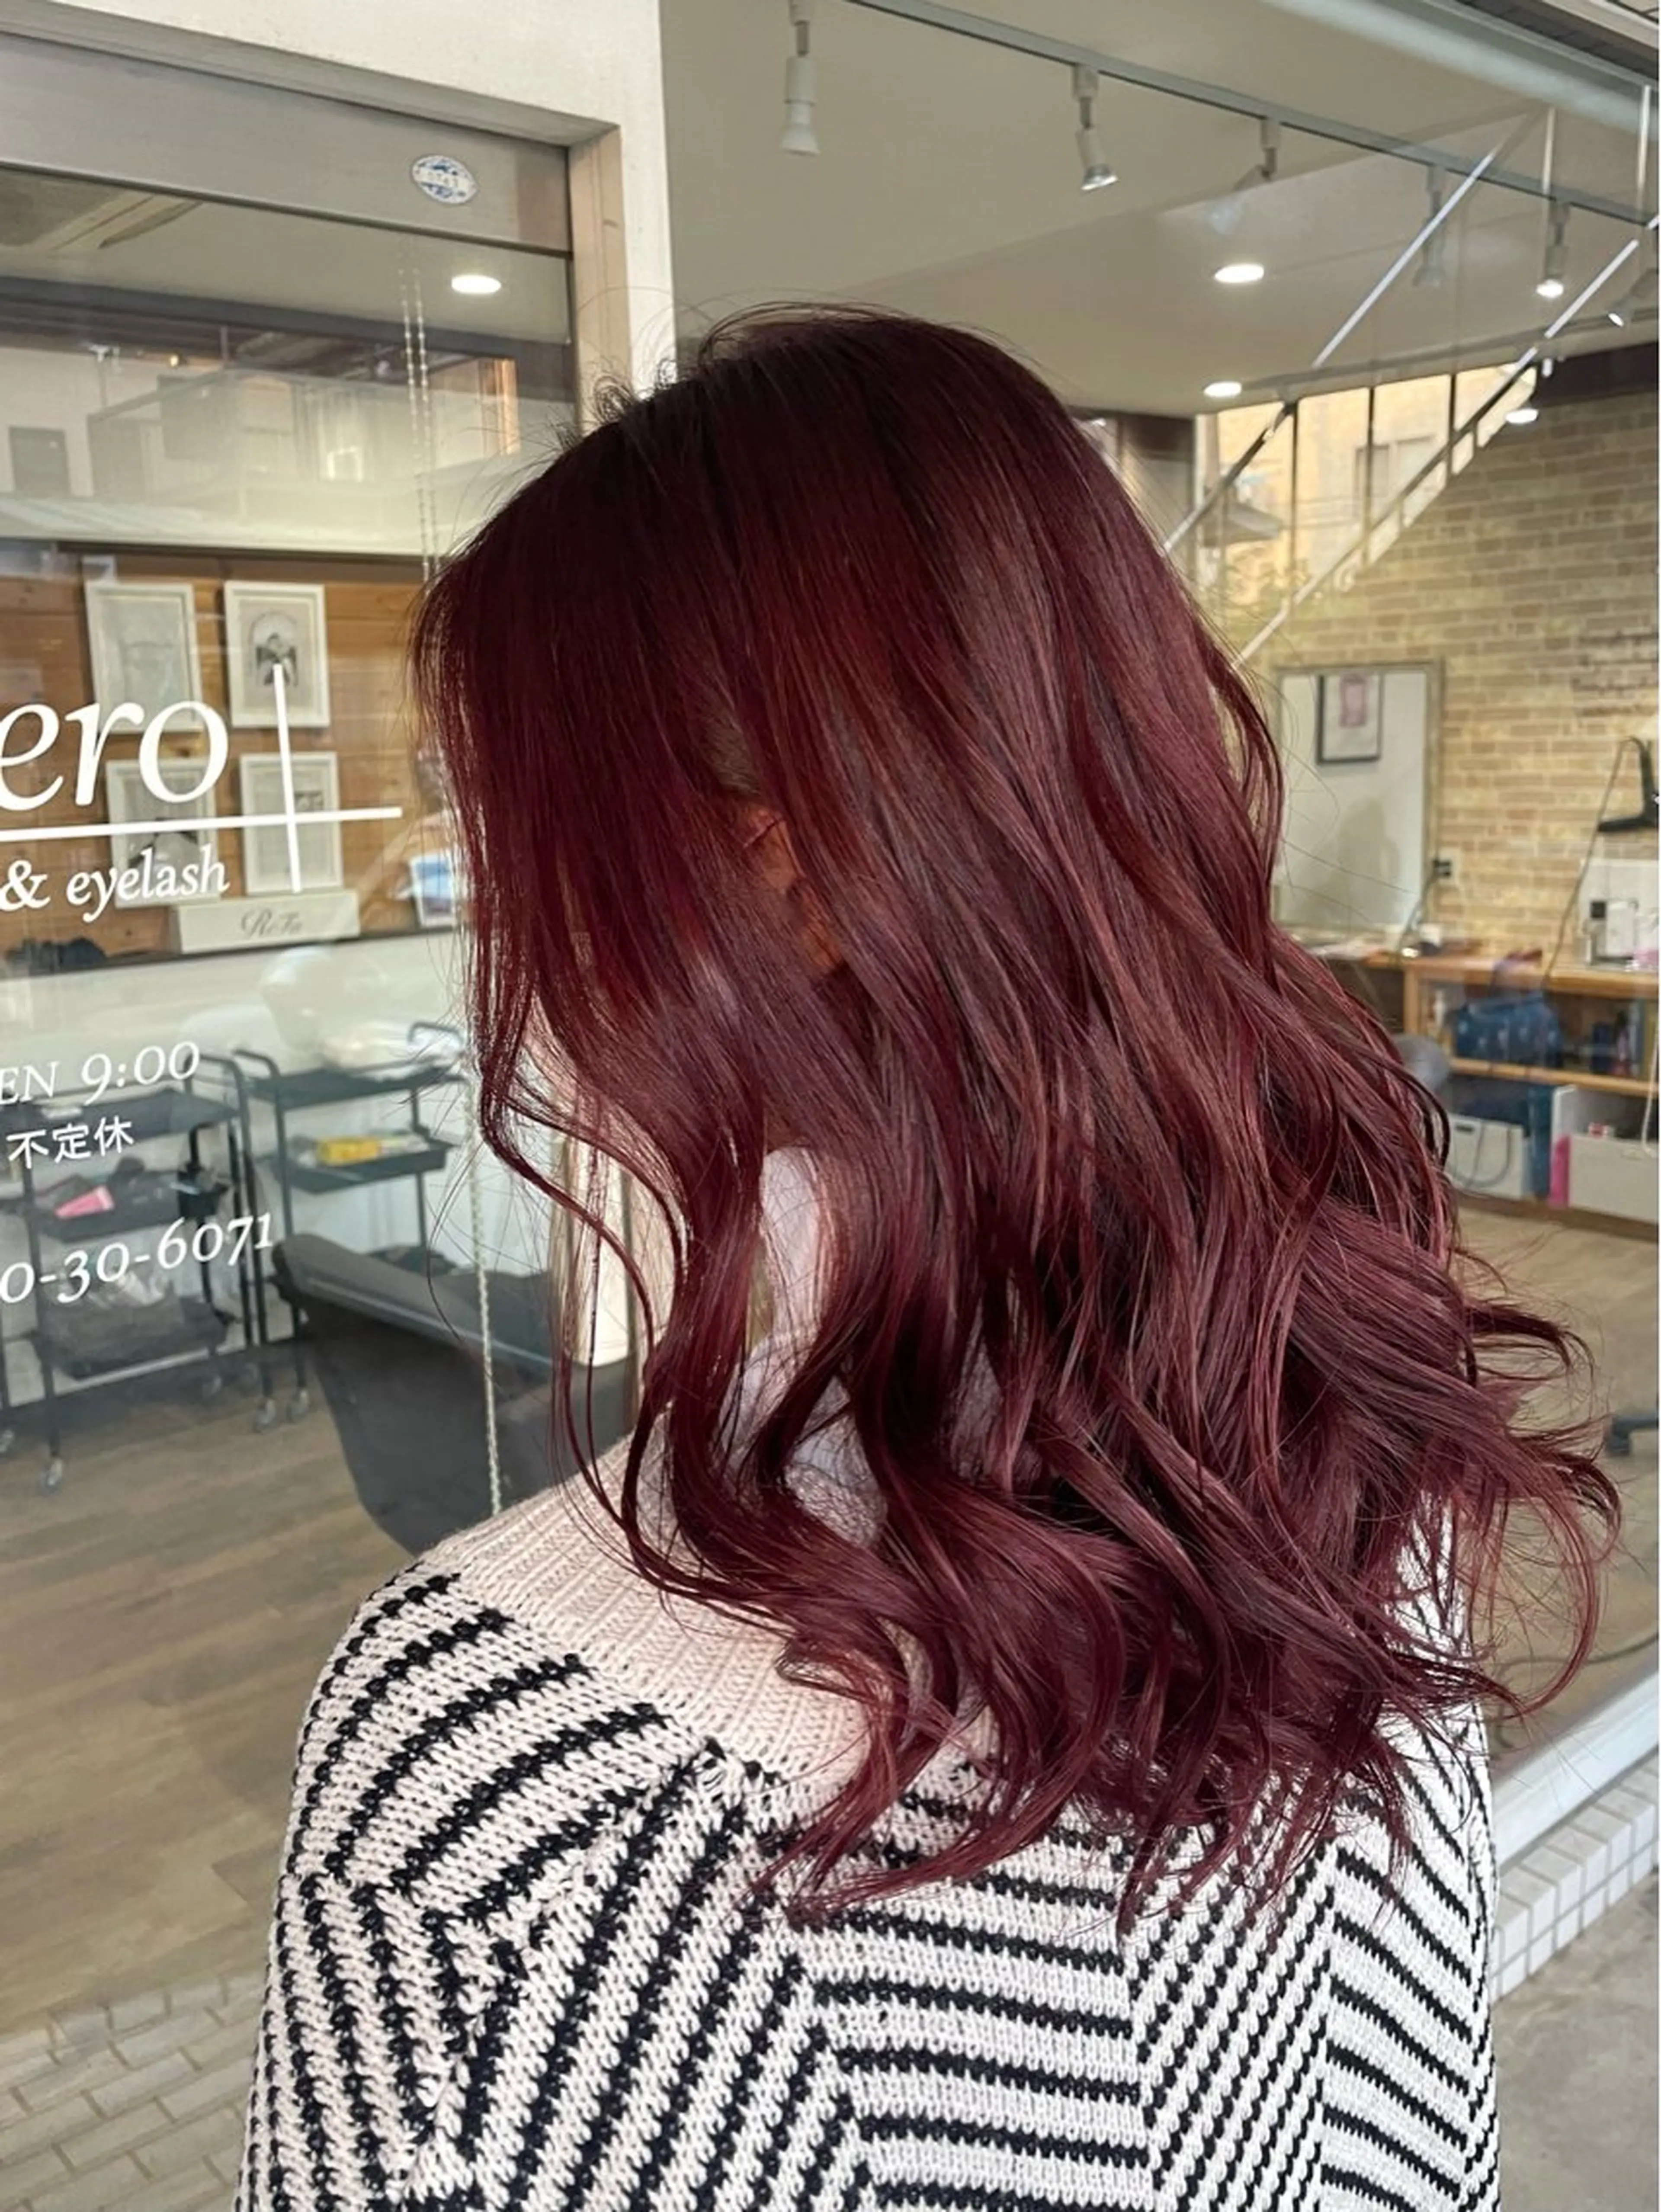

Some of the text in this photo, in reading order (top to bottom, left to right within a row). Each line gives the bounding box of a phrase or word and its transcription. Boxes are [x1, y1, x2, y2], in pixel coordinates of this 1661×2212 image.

[0, 701, 228, 811] ero
[0, 843, 231, 923] & eyelash
[81, 1041, 200, 1106] 9:00
[6, 1115, 135, 1169] 不定休
[0, 1212, 273, 1304] 0-30-6071
